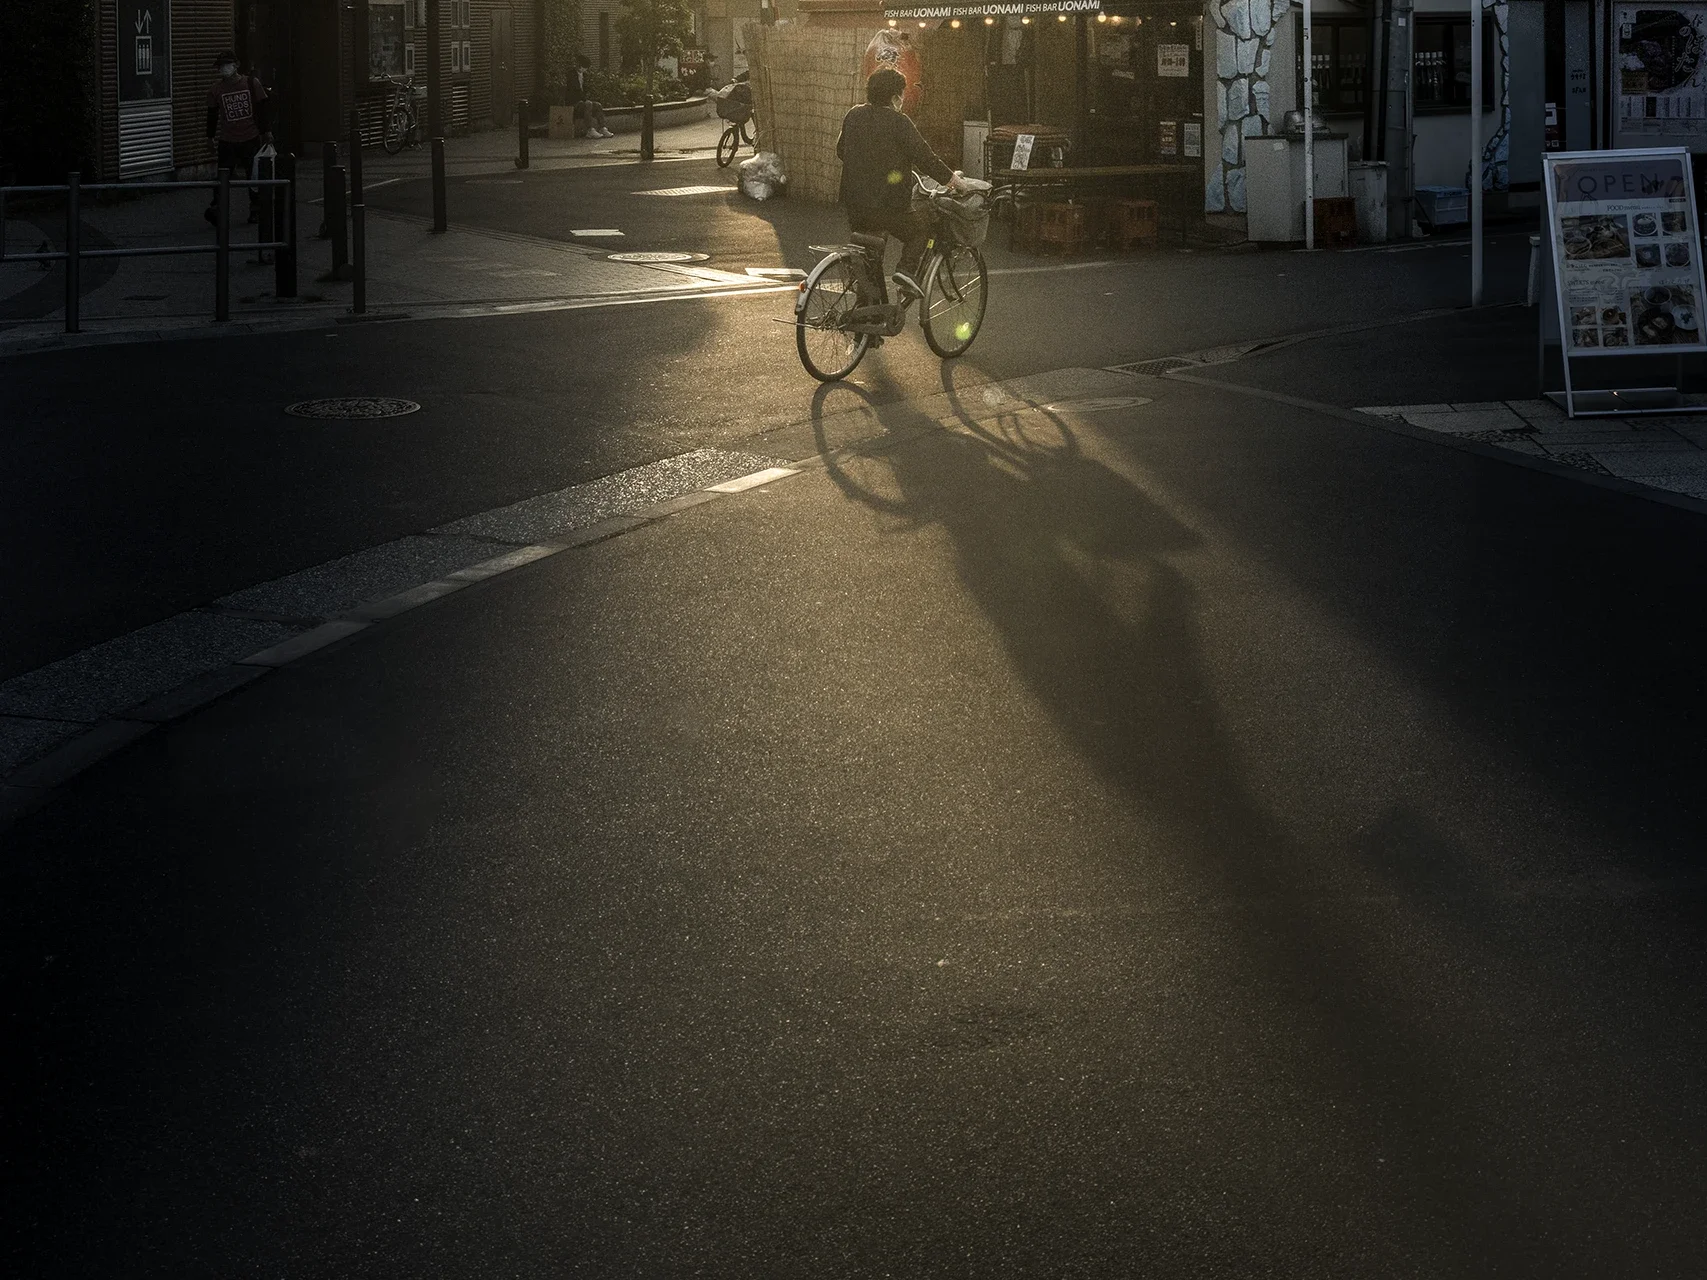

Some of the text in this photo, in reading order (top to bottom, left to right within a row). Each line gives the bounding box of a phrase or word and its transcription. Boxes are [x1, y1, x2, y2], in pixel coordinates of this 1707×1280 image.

[884, 0, 1100, 18] FISH BAR UONAMI FISH BAR UONAMI FISH BAR UONAMI
[225, 93, 248, 104] HUND
[227, 101, 249, 111] REDS
[228, 108, 250, 118] CITY
[1578, 173, 1658, 194] OPEN
